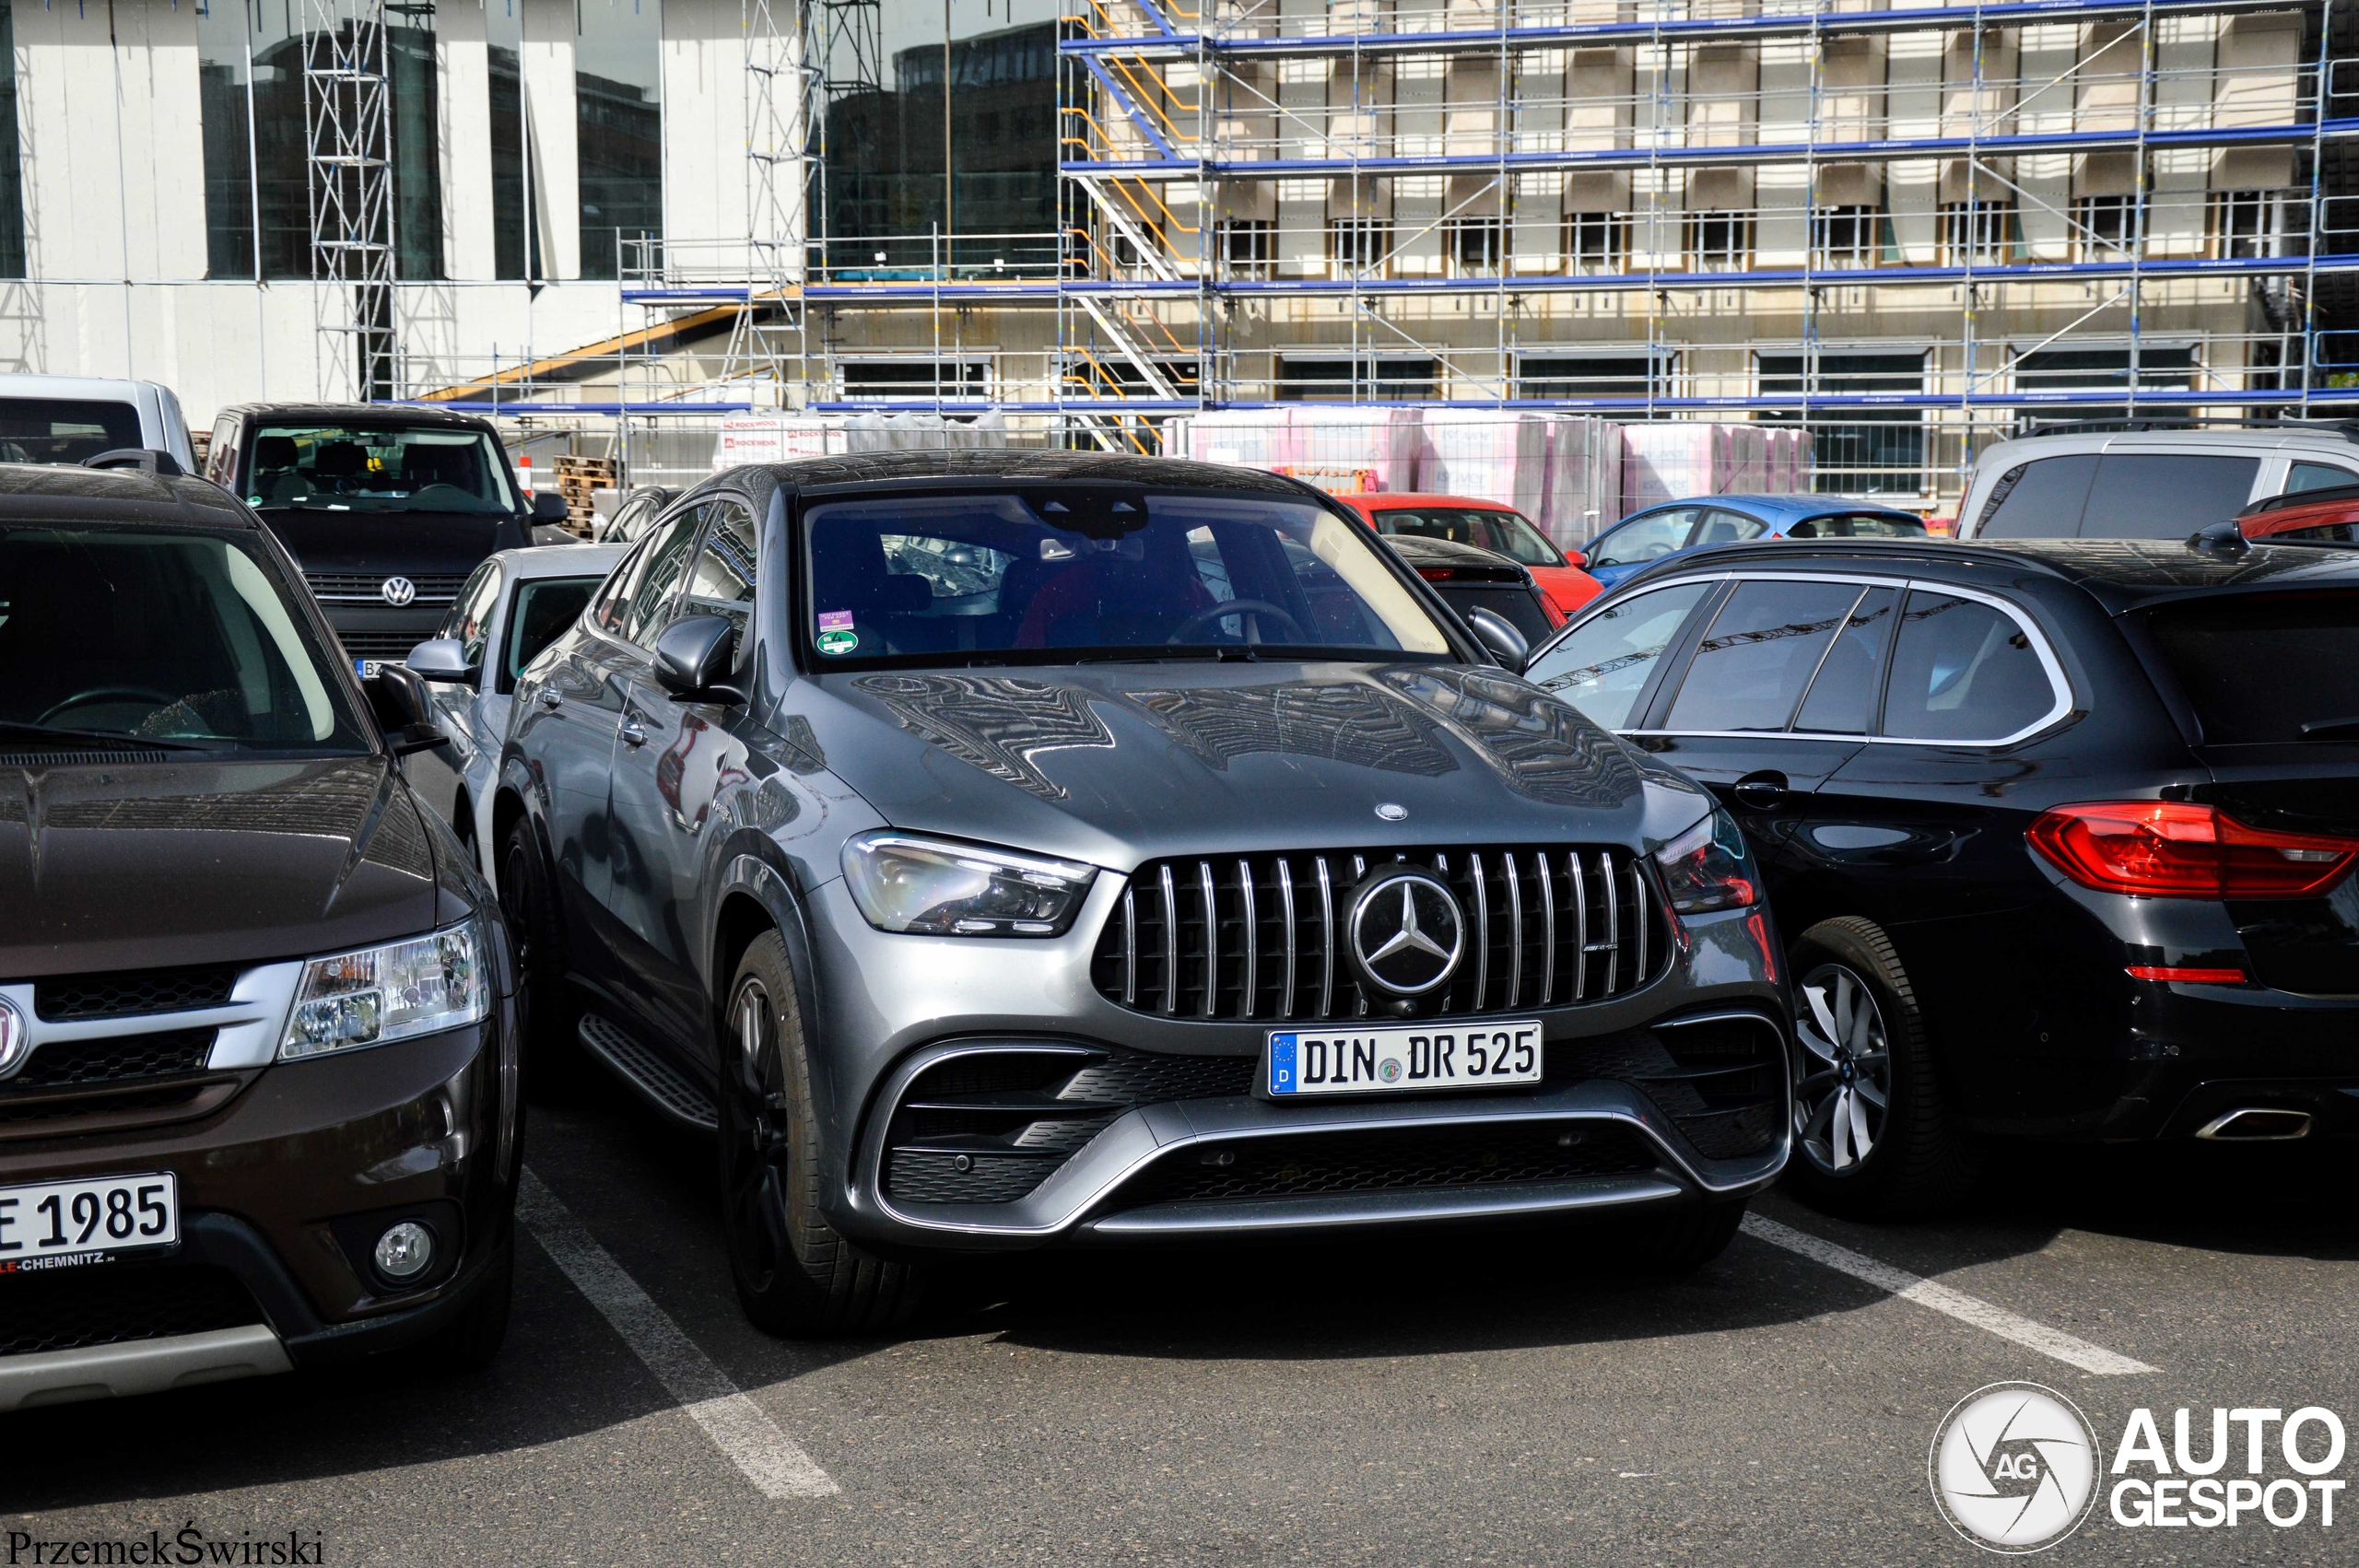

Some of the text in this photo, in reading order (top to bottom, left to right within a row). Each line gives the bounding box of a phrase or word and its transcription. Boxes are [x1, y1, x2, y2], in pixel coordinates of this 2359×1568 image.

[1279, 1070, 1288, 1082] D
[1304, 1038, 1376, 1084] DIN
[1408, 1035, 1455, 1080] DR
[1467, 1031, 1535, 1076] 525
[36, 1184, 168, 1247] 1985
